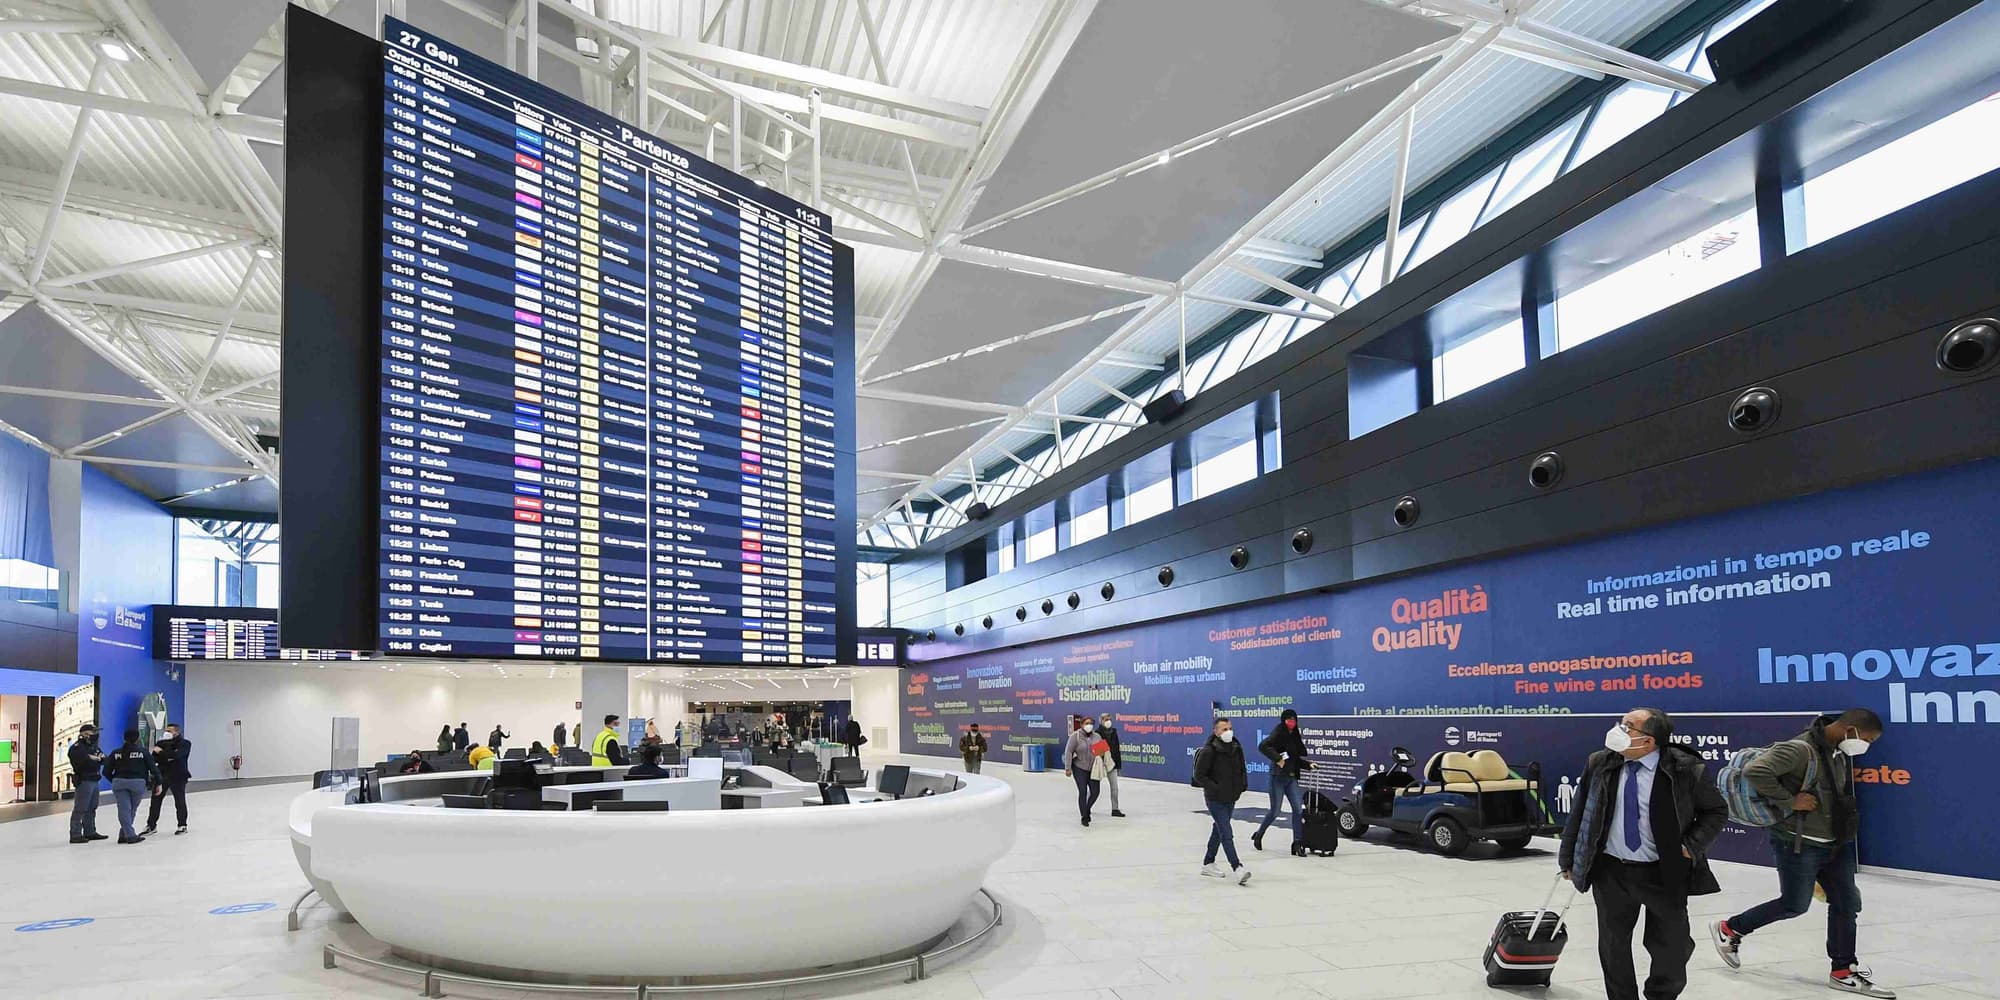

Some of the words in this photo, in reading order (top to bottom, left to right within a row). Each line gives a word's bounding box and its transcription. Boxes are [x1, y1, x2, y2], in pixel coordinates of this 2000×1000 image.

[399, 31, 421, 49] 27
[424, 43, 459, 67] Gen
[388, 49, 421, 69] Orario
[422, 64, 485, 96] Destinazione
[552, 119, 572, 133] Volo
[621, 128, 689, 169] Partenze
[796, 208, 821, 227] 11:21
[1587, 560, 1718, 594] Informazioni
[1725, 557, 1747, 575] in
[1755, 544, 1842, 575] tempo
[1851, 529, 1931, 557] reale
[1557, 597, 1602, 620] Real
[1607, 591, 1659, 614] time
[1665, 569, 1832, 609] information
[1391, 585, 1488, 625] Qualità
[1209, 626, 1257, 643] Customer
[1260, 616, 1327, 635] satisfaction
[1372, 621, 1462, 653] Quality
[1230, 636, 1289, 651] Soddisfazione
[1291, 632, 1305, 644] del
[1308, 628, 1341, 642] cliente
[966, 664, 1003, 679] Innovazione
[1133, 661, 1158, 674] Urban
[1160, 659, 1172, 672] air
[1174, 656, 1213, 672] mobility
[1448, 663, 1524, 679] Eccellenza
[1528, 649, 1693, 680] enogastronomica
[1056, 668, 1116, 687] Sostenibilità
[1144, 674, 1172, 685] Mobilità
[1173, 674, 1195, 684] aerea
[1197, 671, 1225, 682] urbana
[1296, 667, 1357, 682] Biometrics
[978, 676, 1012, 689] Innovation
[1310, 681, 1365, 694] Biometrico
[1514, 679, 1549, 695] Fine
[1554, 678, 1595, 693] wine
[1600, 676, 1637, 691] and
[1642, 672, 1704, 690] foods
[1063, 685, 1131, 705] Sustainability
[1230, 695, 1256, 706] Green
[1258, 694, 1293, 705] finance
[1888, 682, 2000, 723] Inn
[1213, 707, 1242, 718] Finanza
[1243, 706, 1286, 717] sostenibil
[1384, 704, 1396, 716] al
[1399, 704, 1493, 716] cambiamento
[1494, 703, 1571, 716] climatico
[1115, 713, 1147, 723] Passengers
[1148, 714, 1165, 722] come
[1166, 713, 1179, 722] first
[1124, 724, 1155, 735] Passeggeri
[1163, 725, 1182, 735] primo
[1183, 726, 1203, 736] posto
[1303, 728, 1322, 736] diamo
[1336, 729, 1373, 739] passaggio
[1476, 730, 1502, 738] Aeroporti
[1307, 738, 1349, 748] raggiungere
[1669, 733, 1692, 744] ive
[1696, 735, 1728, 747] you
[1142, 744, 1160, 754] 2030
[1315, 747, 1350, 757] d'imbarco
[1351, 749, 1357, 757] E
[1149, 755, 1165, 765] 2030
